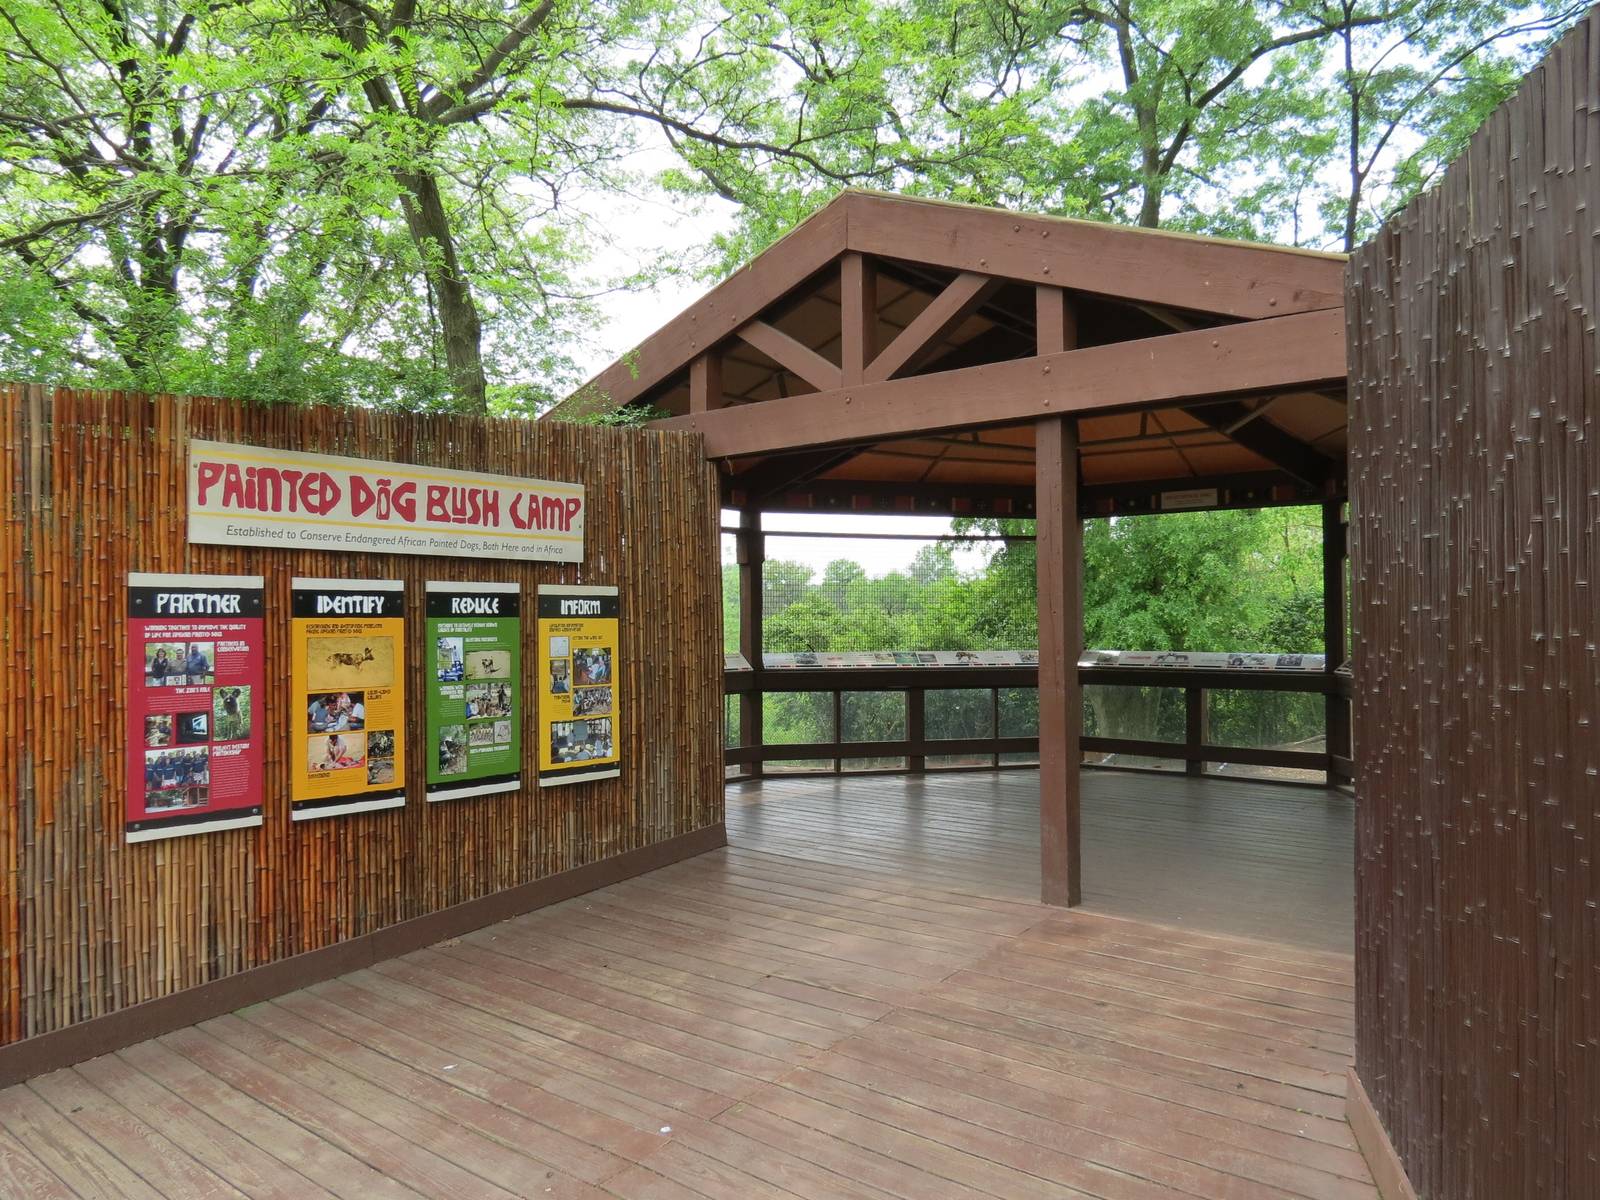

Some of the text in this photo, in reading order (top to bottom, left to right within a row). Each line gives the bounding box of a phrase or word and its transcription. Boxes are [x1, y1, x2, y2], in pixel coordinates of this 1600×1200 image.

[197, 461, 582, 532] PAINTED DOG BUSH CAMP
[226, 524, 563, 556] Established to Conserve Endangered African Painted Dogs, Both Here and in Africa
[156, 593, 241, 614] PARTNER
[317, 595, 385, 614] IDENTIFY
[451, 597, 499, 614] REDUCE
[560, 599, 601, 615] INFORM
